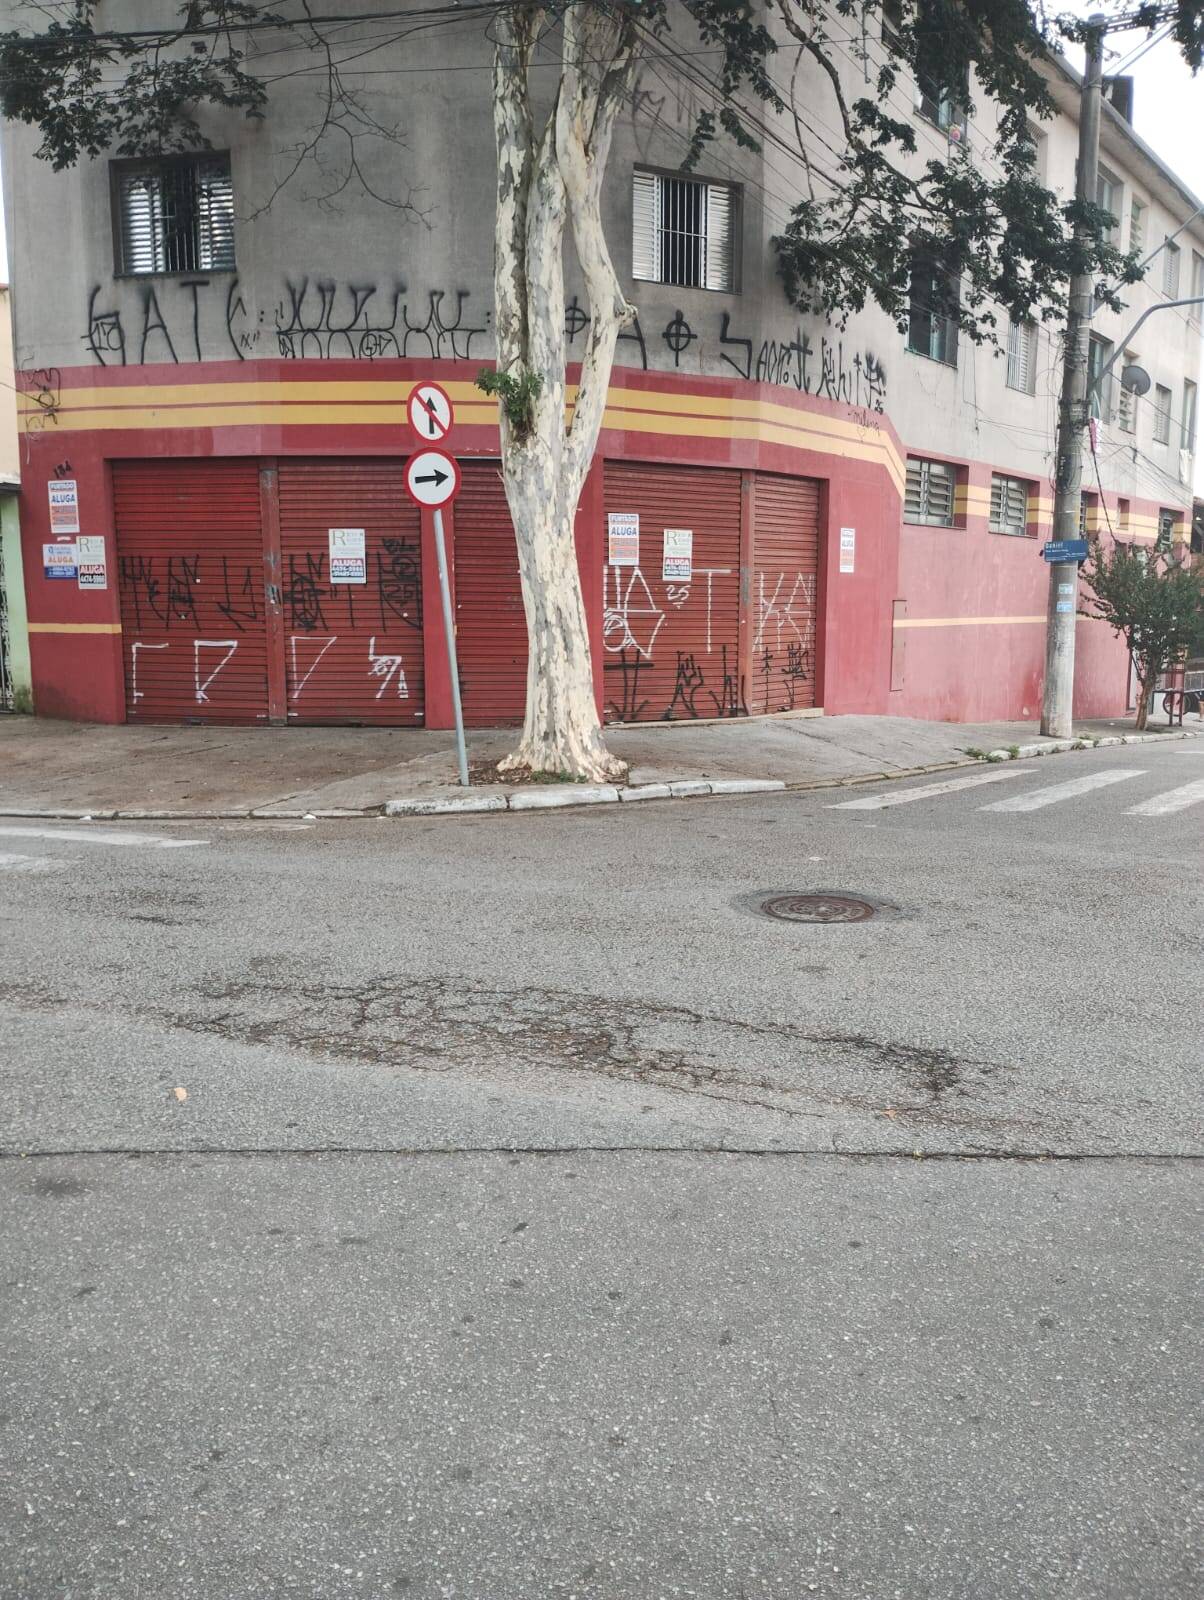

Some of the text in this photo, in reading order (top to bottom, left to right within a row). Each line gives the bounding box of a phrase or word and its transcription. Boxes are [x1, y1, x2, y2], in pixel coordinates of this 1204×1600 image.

[52, 494, 75, 502] ALUGA
[611, 526, 637, 536] ALUGA
[332, 559, 363, 567] ALUGA
[665, 558, 690, 566] ALUGA
[80, 564, 105, 574] ALUGA
